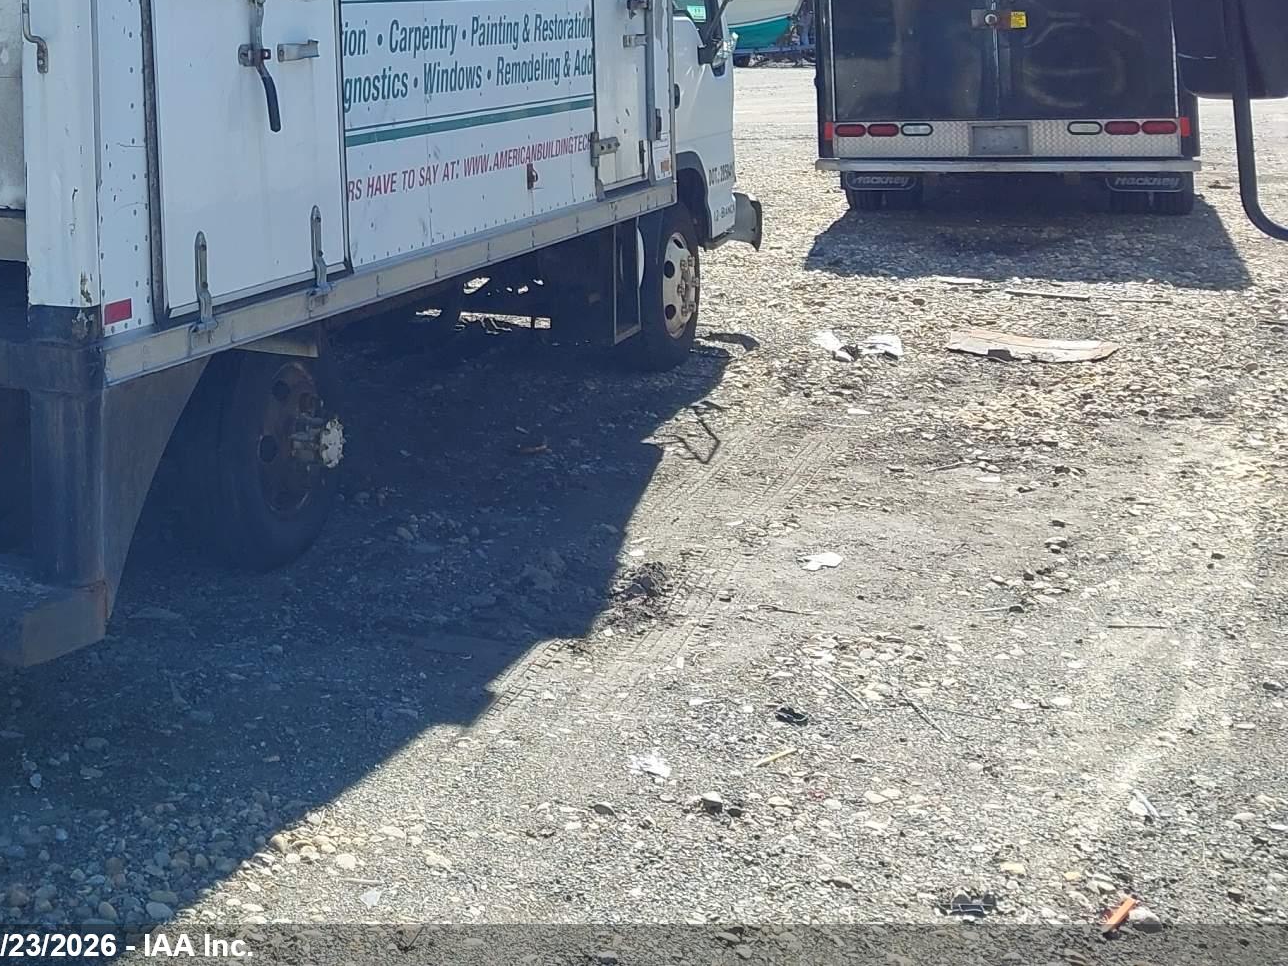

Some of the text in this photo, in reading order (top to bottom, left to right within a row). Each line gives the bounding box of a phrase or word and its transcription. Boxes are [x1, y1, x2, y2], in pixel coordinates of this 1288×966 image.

[389, 19, 457, 58] Carpentry
[471, 15, 519, 50] Painting
[522, 14, 530, 43] &
[424, 61, 482, 95] Windows
[496, 52, 560, 86] Remodeling
[563, 51, 570, 77] &
[367, 172, 397, 198] HAVE
[402, 169, 415, 190] TO
[419, 164, 439, 186] SAY
